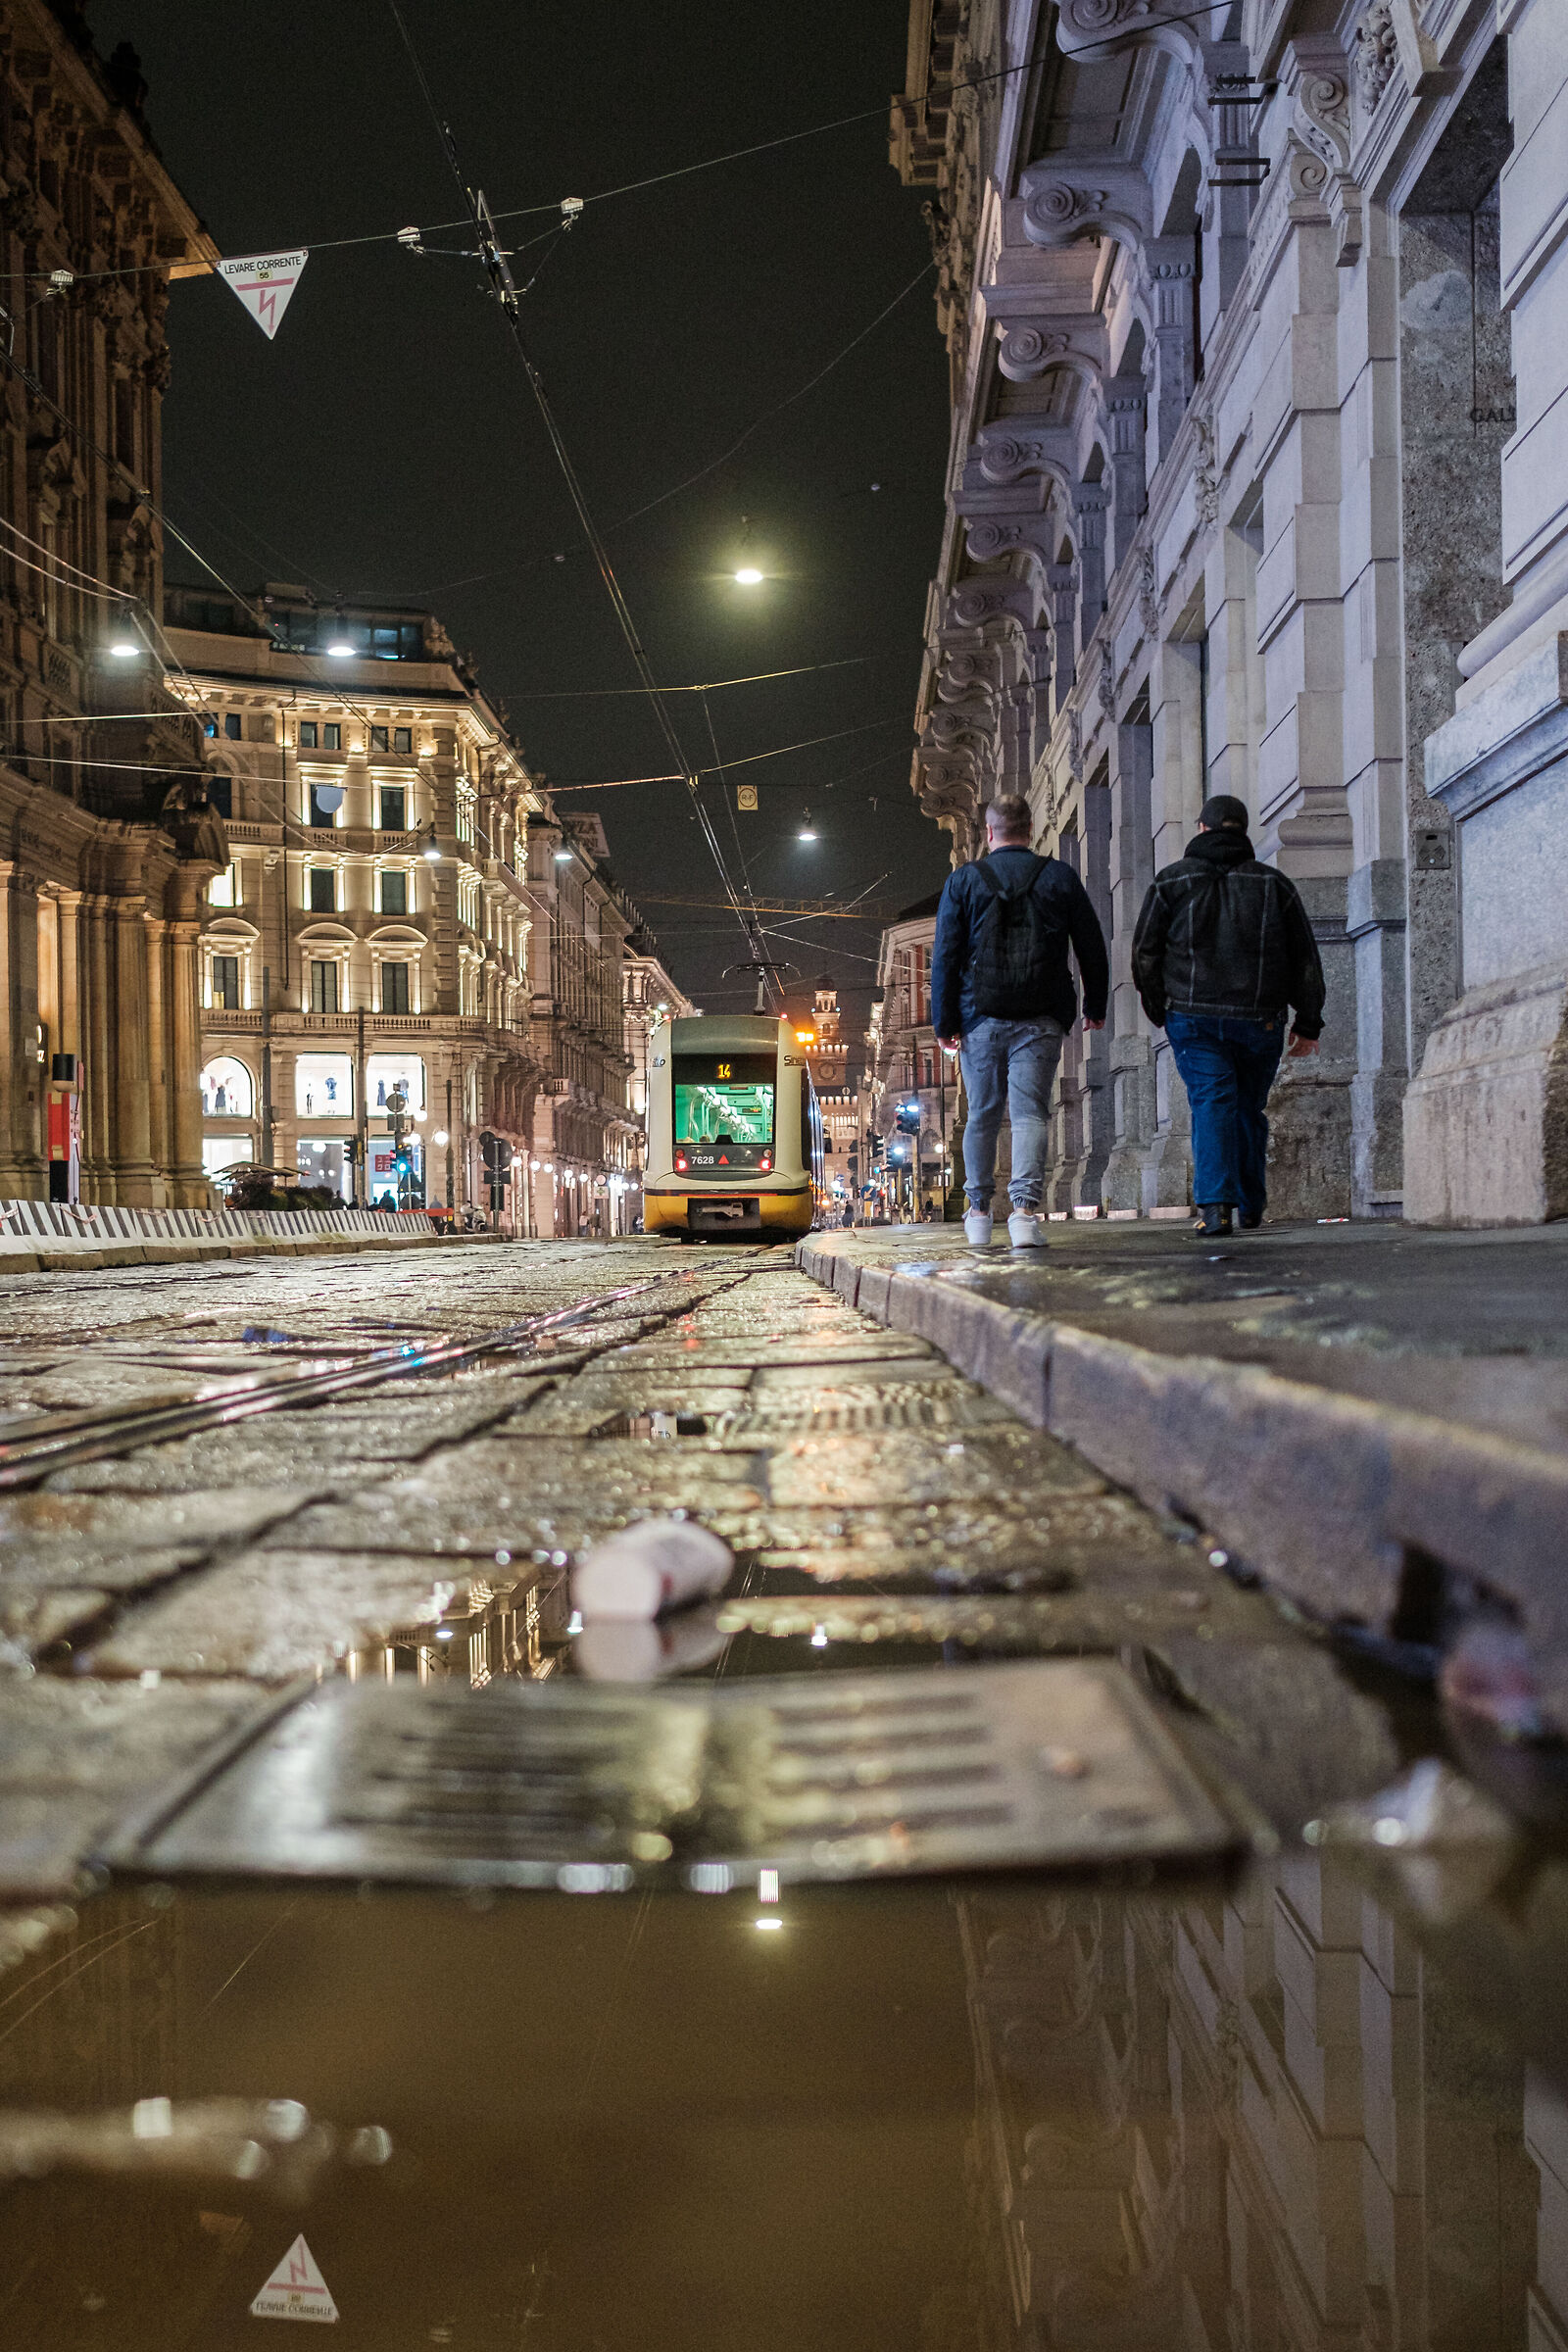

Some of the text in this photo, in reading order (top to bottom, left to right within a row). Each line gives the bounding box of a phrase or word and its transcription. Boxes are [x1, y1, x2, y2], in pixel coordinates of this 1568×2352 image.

[224, 257, 301, 274] LEVARE CORRENTE
[691, 1155, 714, 1164] 7628
